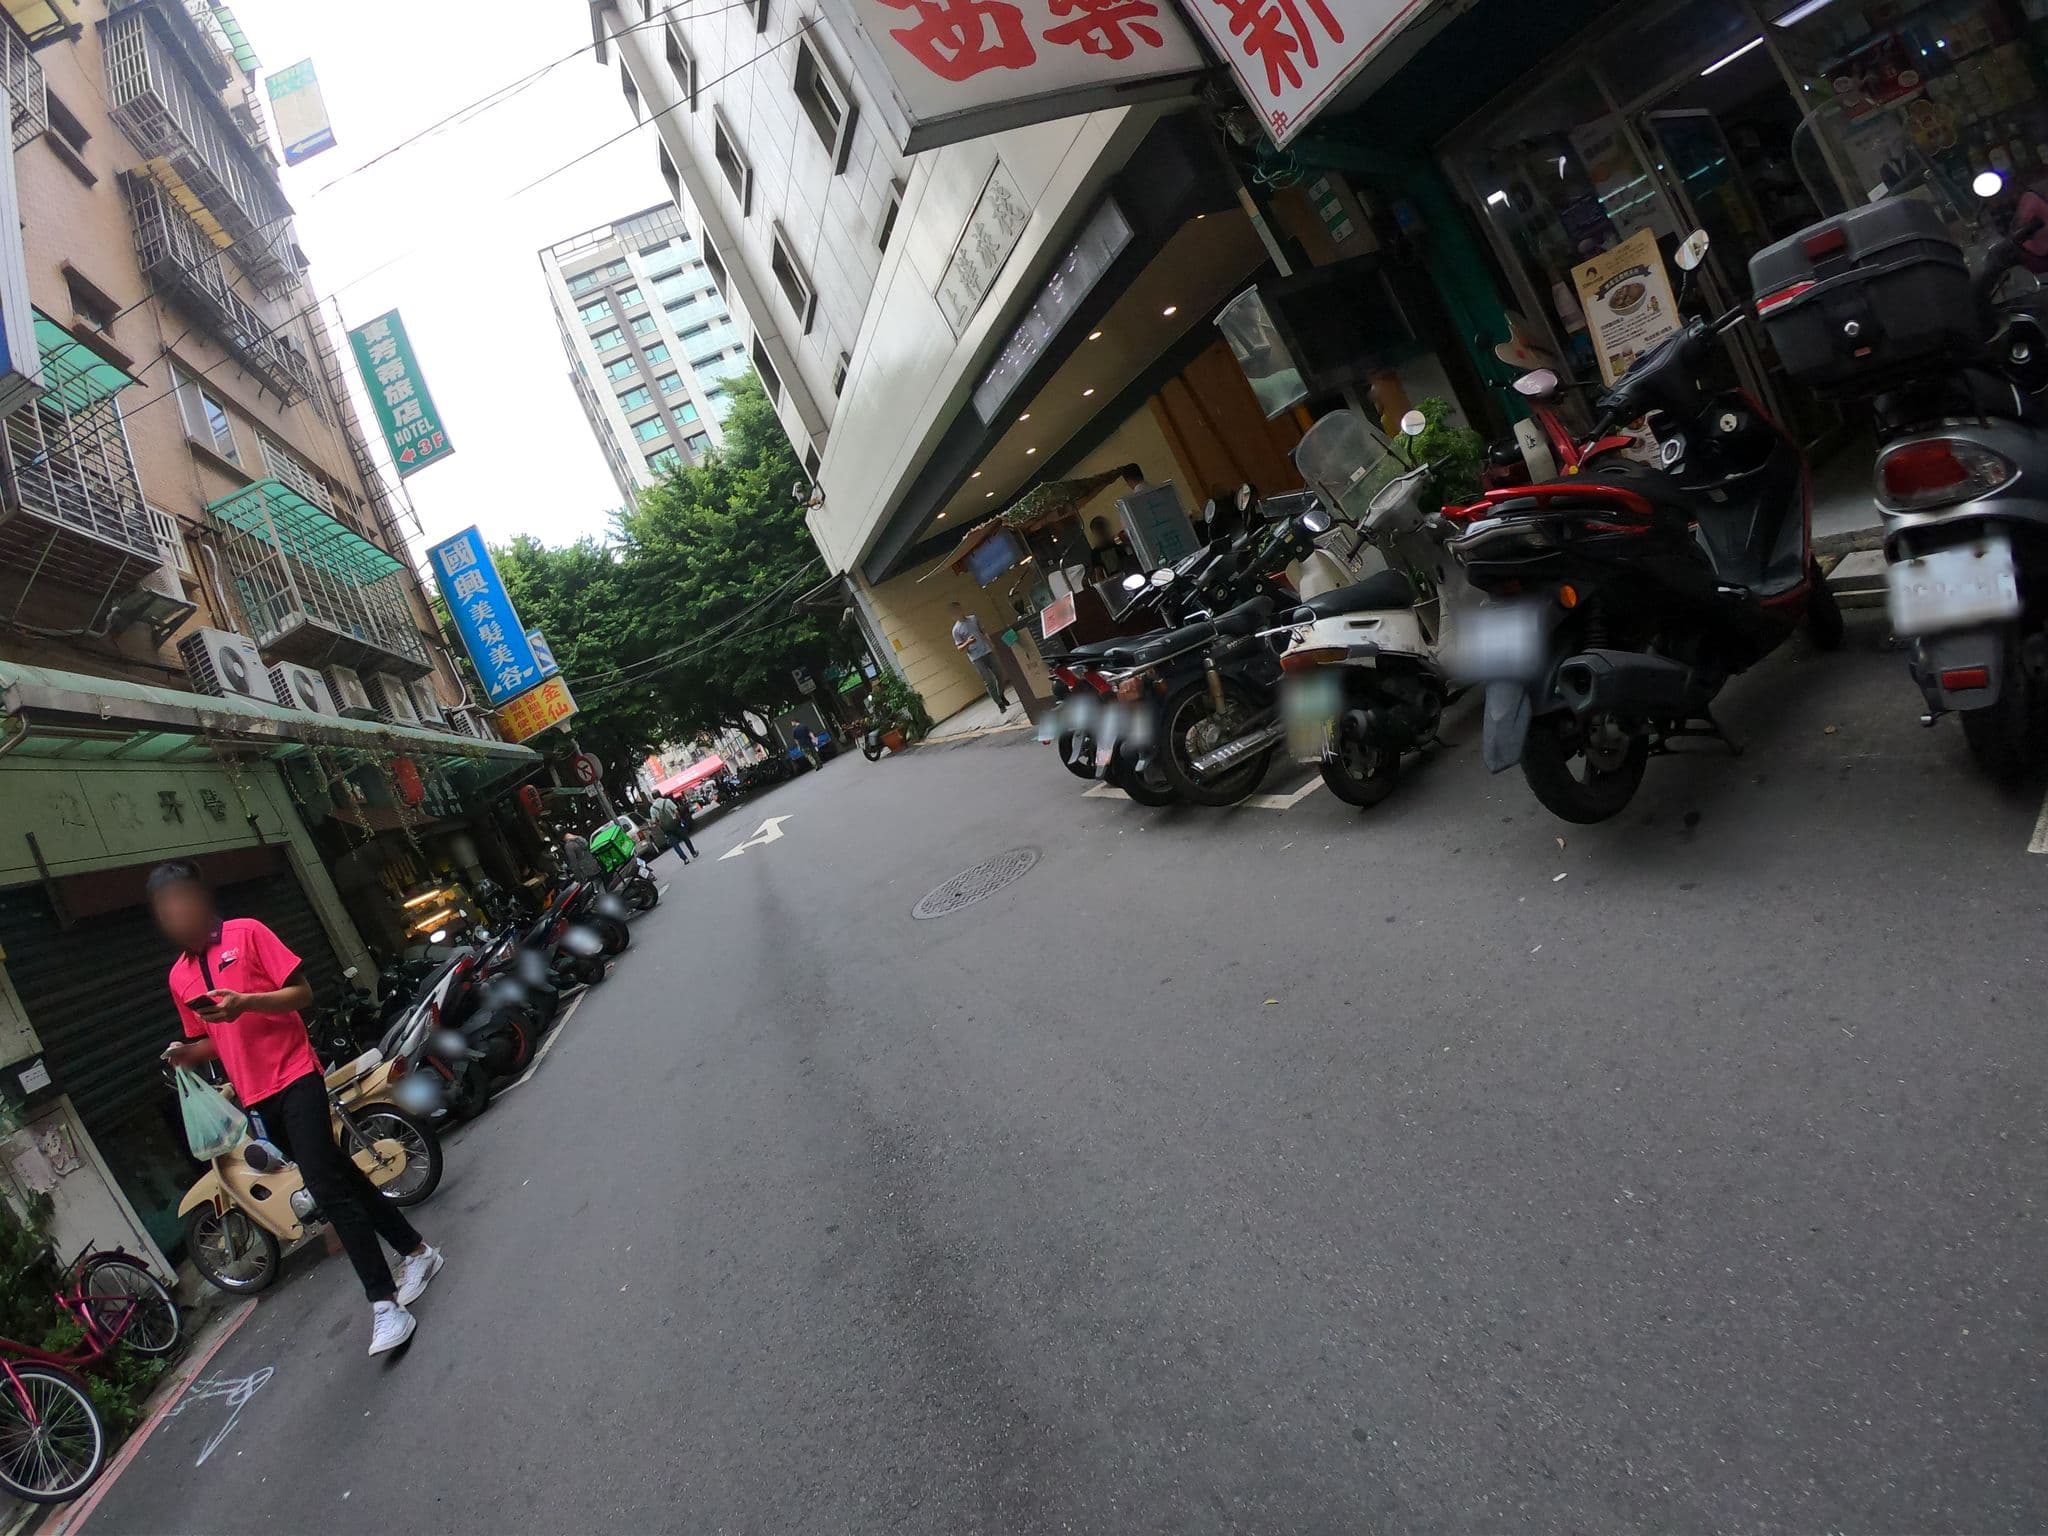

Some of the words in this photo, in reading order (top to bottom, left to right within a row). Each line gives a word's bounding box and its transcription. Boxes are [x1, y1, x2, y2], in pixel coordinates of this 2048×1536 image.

[393, 416, 434, 448] HOTEL
[418, 430, 443, 456] 3F
[438, 535, 524, 692] 國興美髮美容
[541, 683, 569, 721] 金仙
